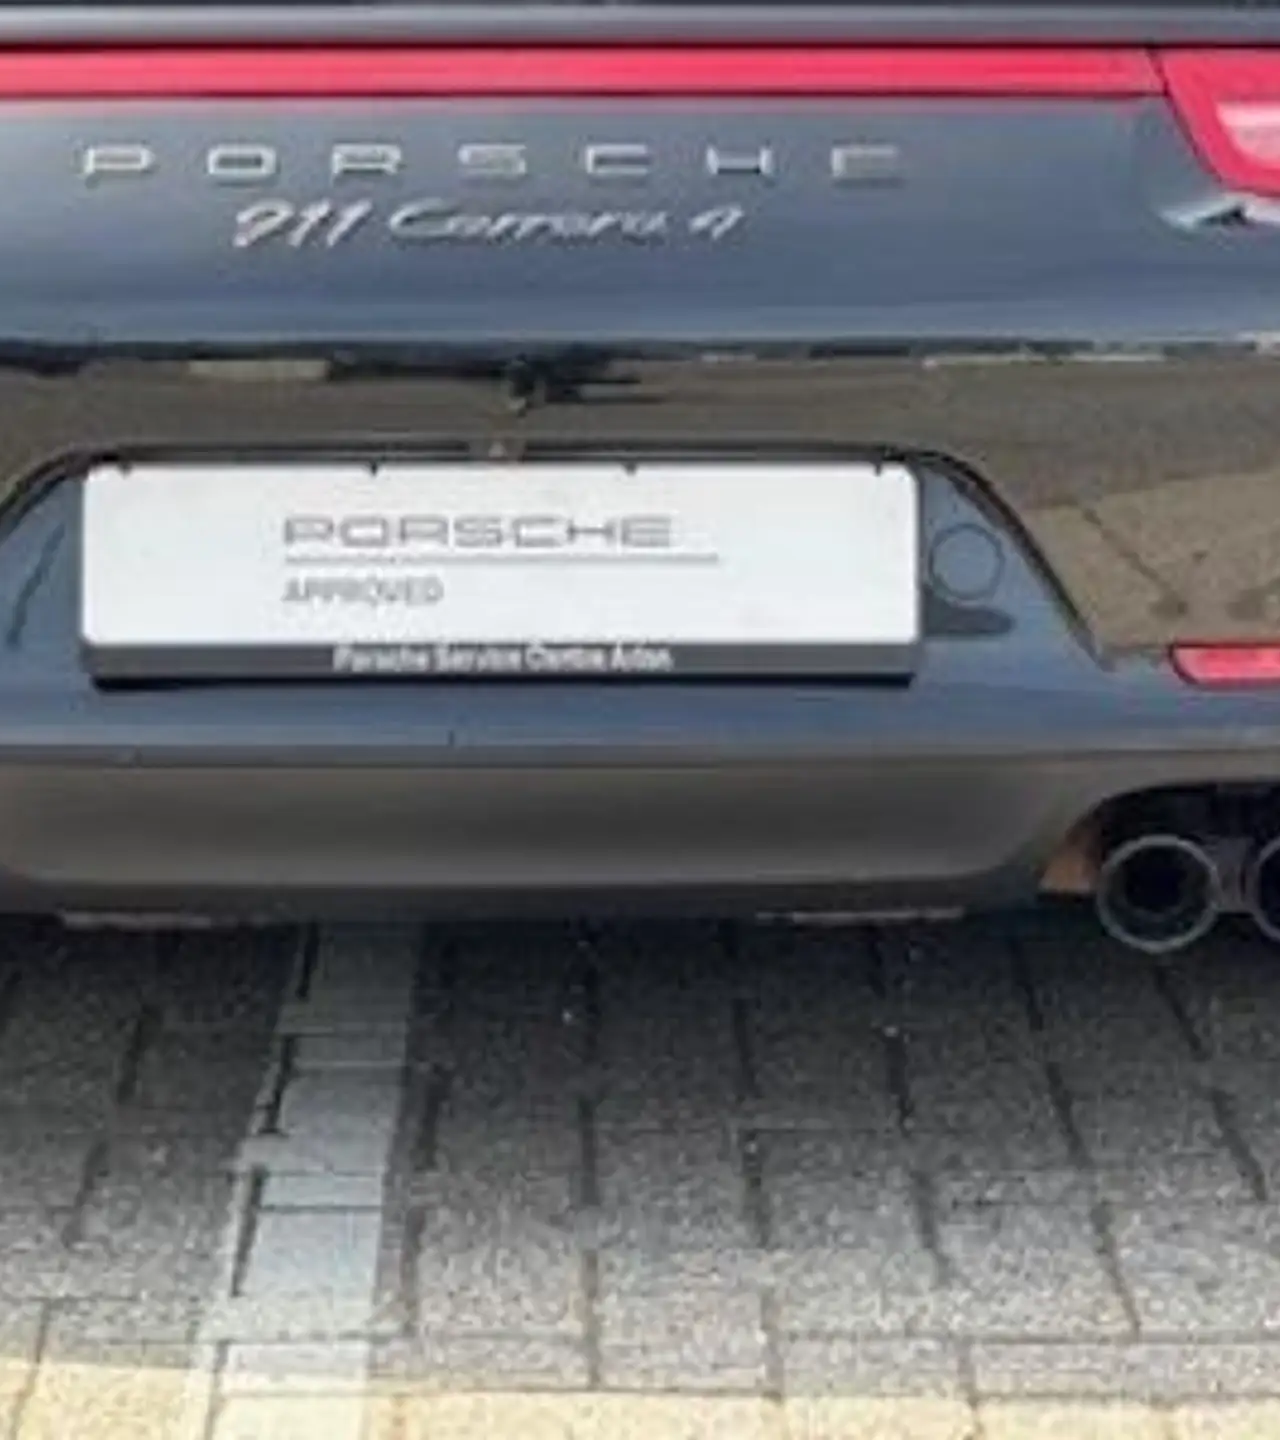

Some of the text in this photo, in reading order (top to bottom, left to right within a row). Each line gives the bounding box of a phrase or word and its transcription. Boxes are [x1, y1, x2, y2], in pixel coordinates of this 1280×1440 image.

[82, 143, 902, 178] PORSCHE
[232, 200, 375, 248] 911
[388, 199, 668, 244] Carrera
[282, 514, 675, 549] PORSCHE
[281, 577, 445, 605] APPROVED
[332, 641, 429, 673] Porsche
[433, 641, 521, 673] Service
